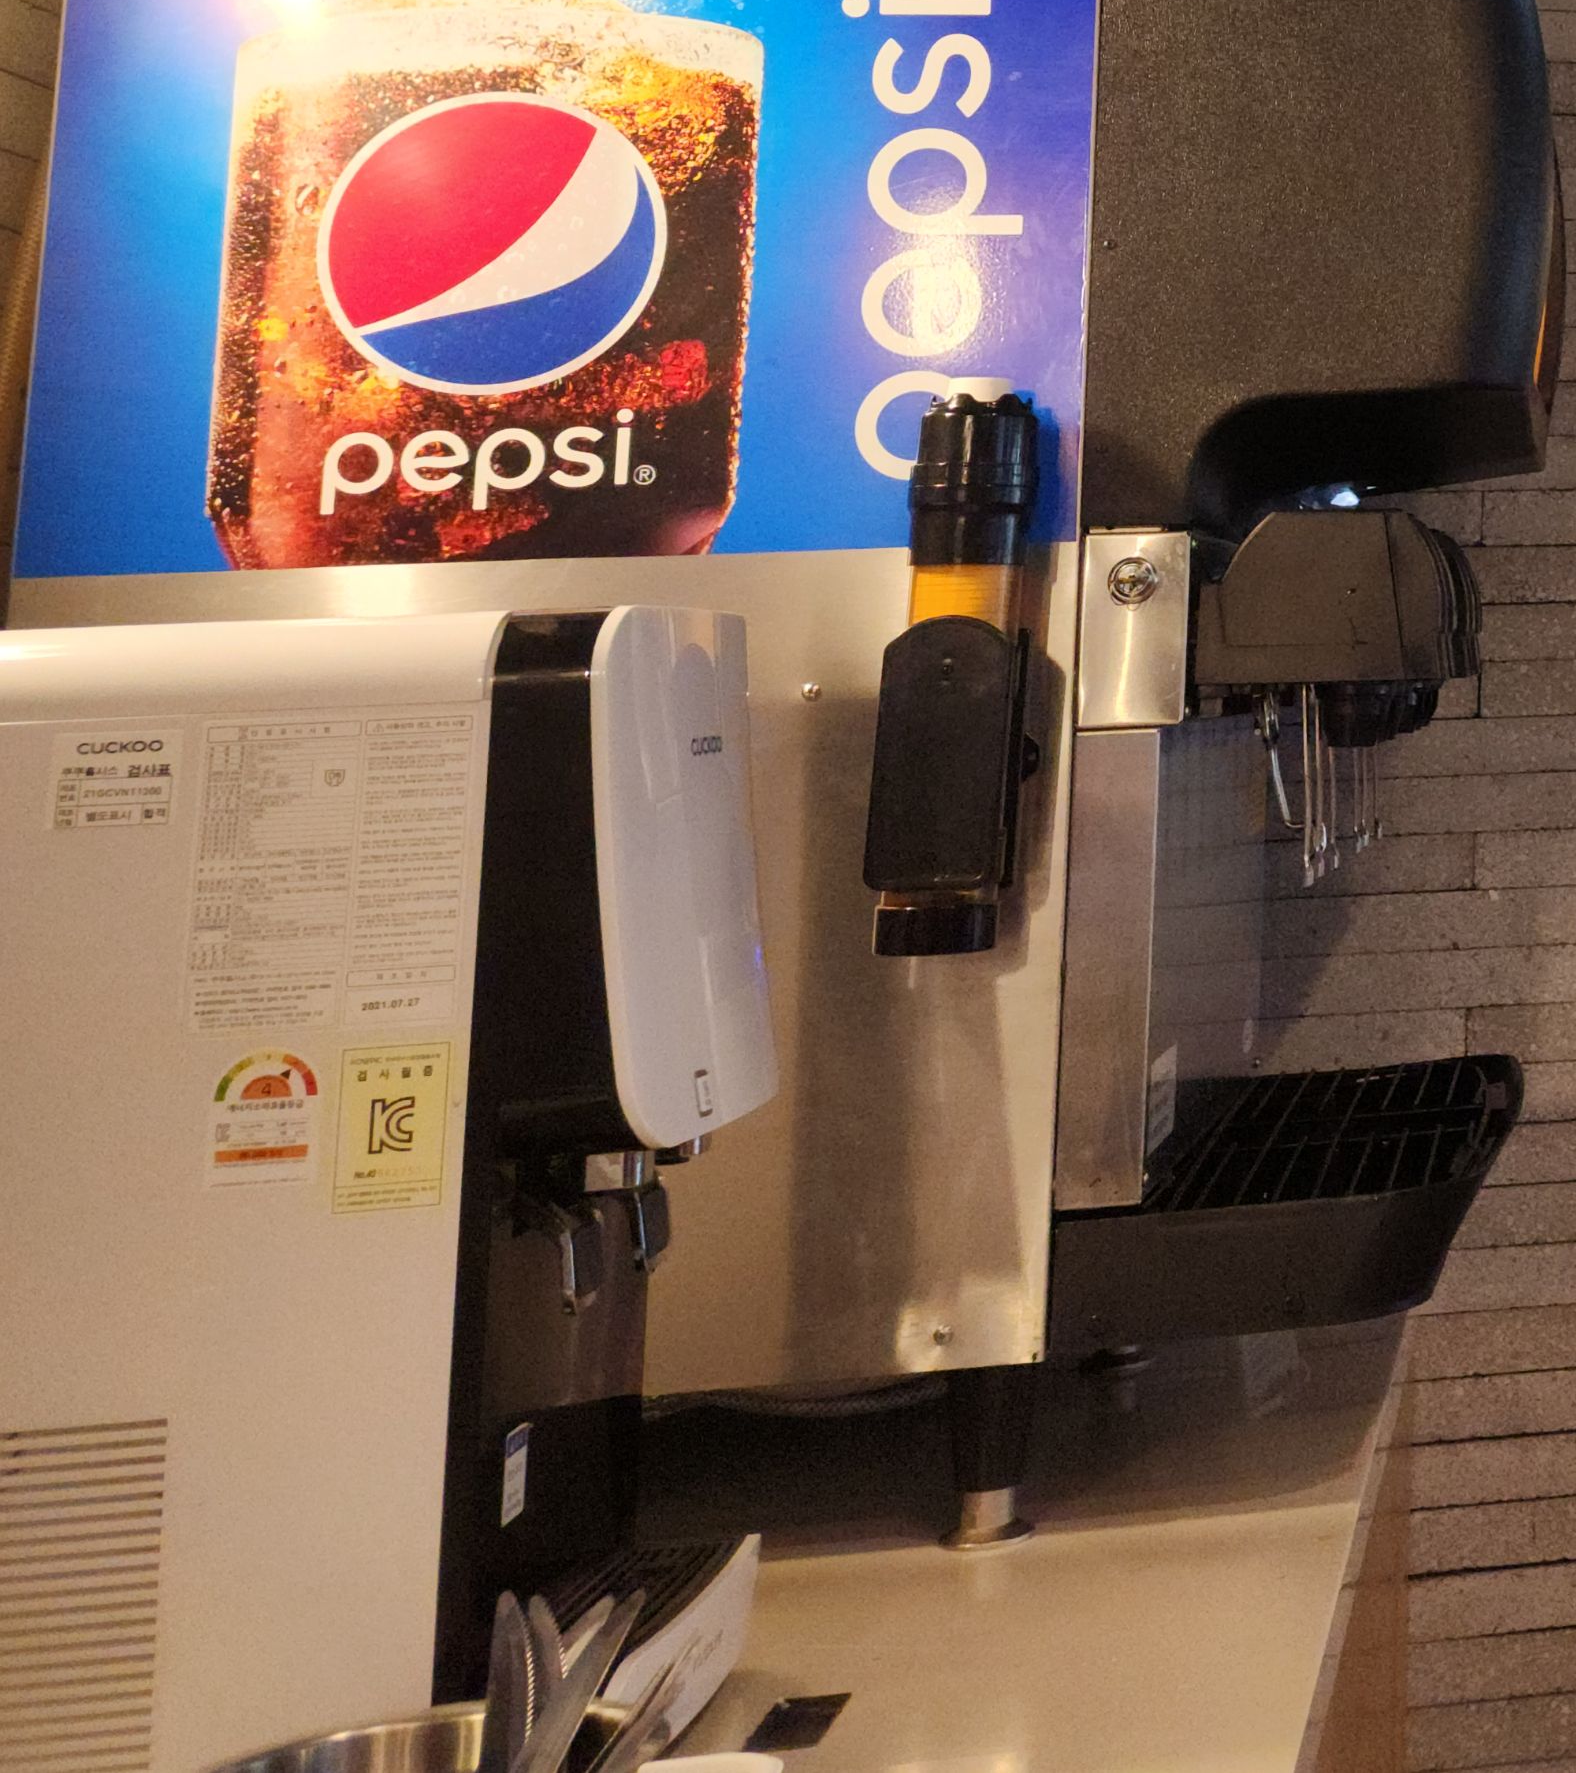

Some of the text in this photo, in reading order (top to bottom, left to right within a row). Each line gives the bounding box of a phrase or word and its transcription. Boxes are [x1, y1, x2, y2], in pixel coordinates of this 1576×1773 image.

[76, 739, 164, 755] CUCKOO
[127, 764, 171, 778] 검사표
[361, 997, 421, 1012] 2021.07.27
[261, 1083, 272, 1095] 4
